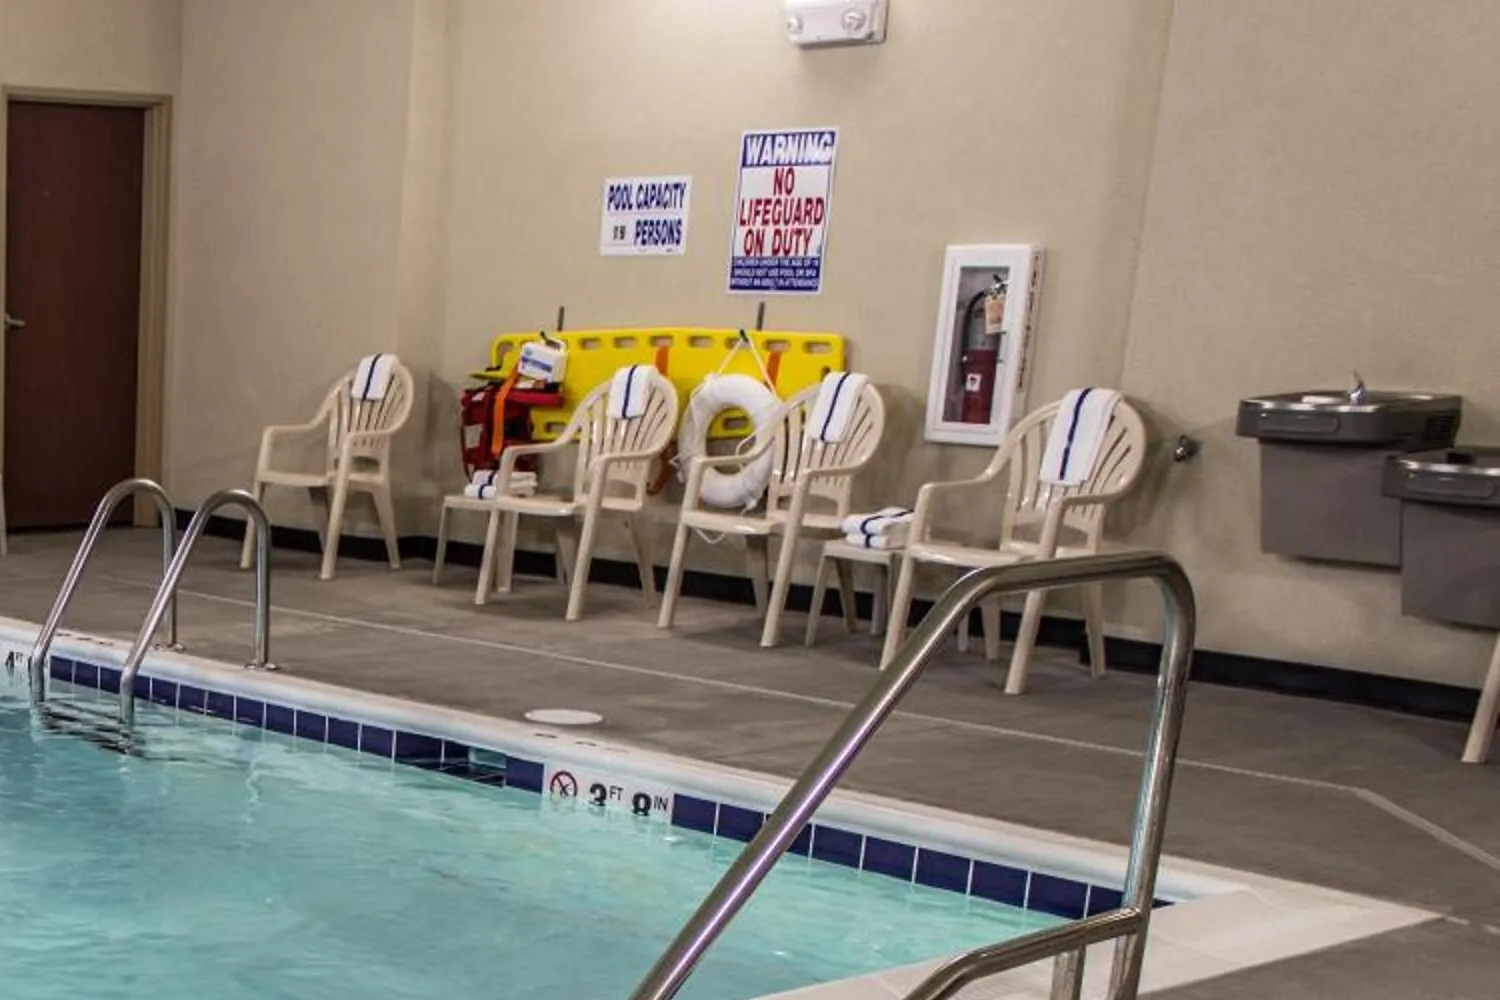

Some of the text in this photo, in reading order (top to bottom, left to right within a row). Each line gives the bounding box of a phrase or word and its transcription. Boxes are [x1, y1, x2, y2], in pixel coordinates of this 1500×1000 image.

[746, 132, 834, 165] WARNING
[773, 167, 795, 196] NO
[607, 182, 686, 211] POOL CAPACITY
[739, 197, 824, 226] LIFEGUARD
[633, 218, 682, 246] PERSONS
[744, 228, 813, 256] ON DUTY
[609, 786, 624, 800] FT
[653, 795, 669, 812] IN
